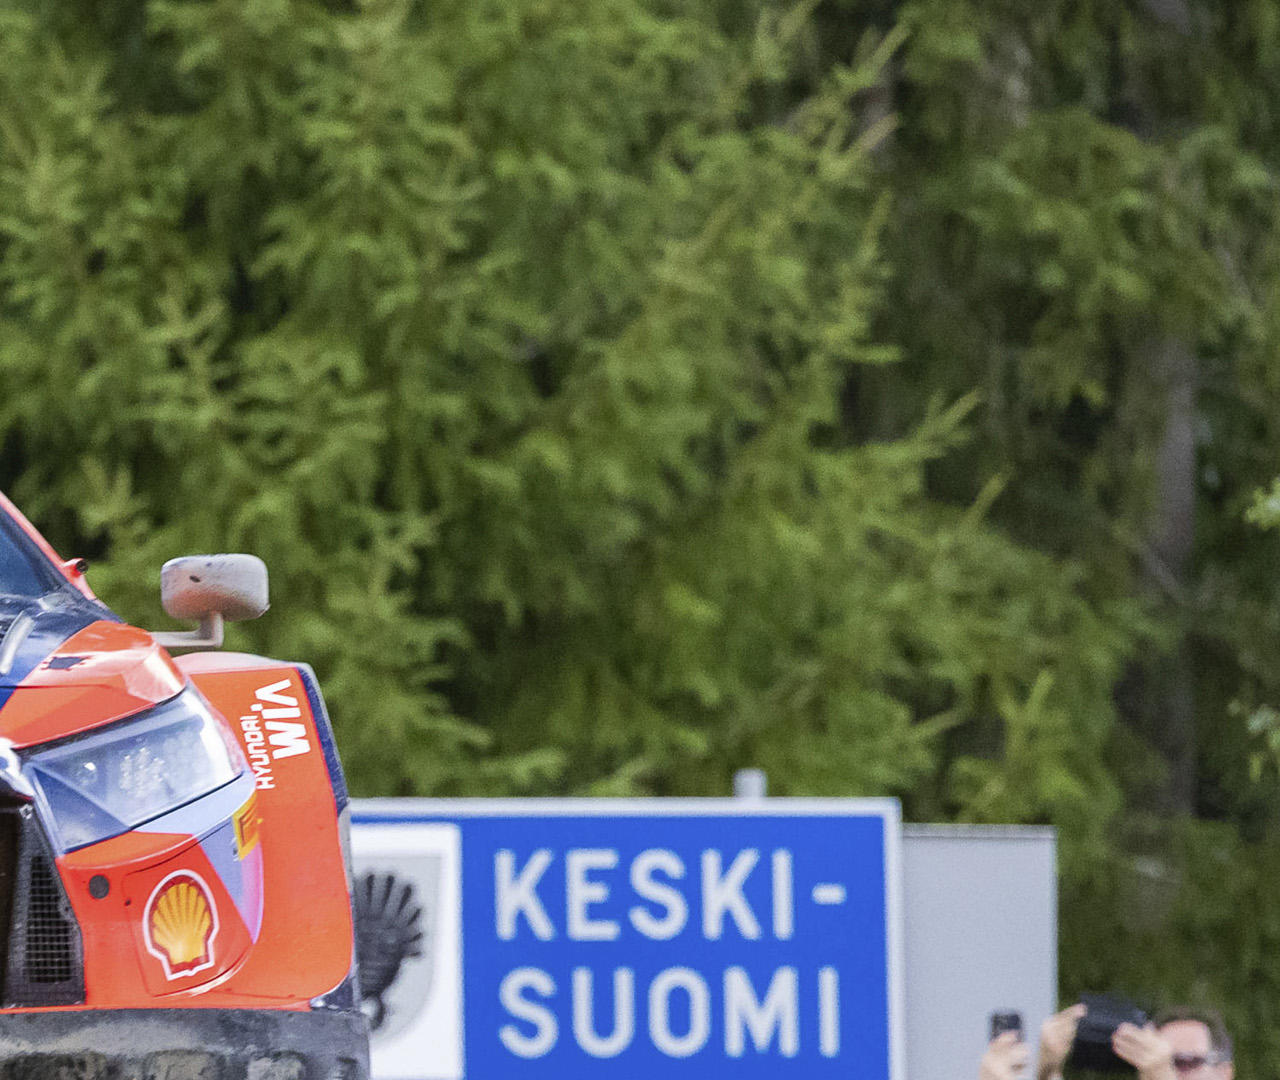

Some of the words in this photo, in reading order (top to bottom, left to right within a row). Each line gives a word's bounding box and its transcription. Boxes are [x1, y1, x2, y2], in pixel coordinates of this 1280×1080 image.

[239, 715, 276, 790] HYUNDAI
[494, 847, 847, 941] KESKI-
[497, 965, 841, 1058] SUOMI
